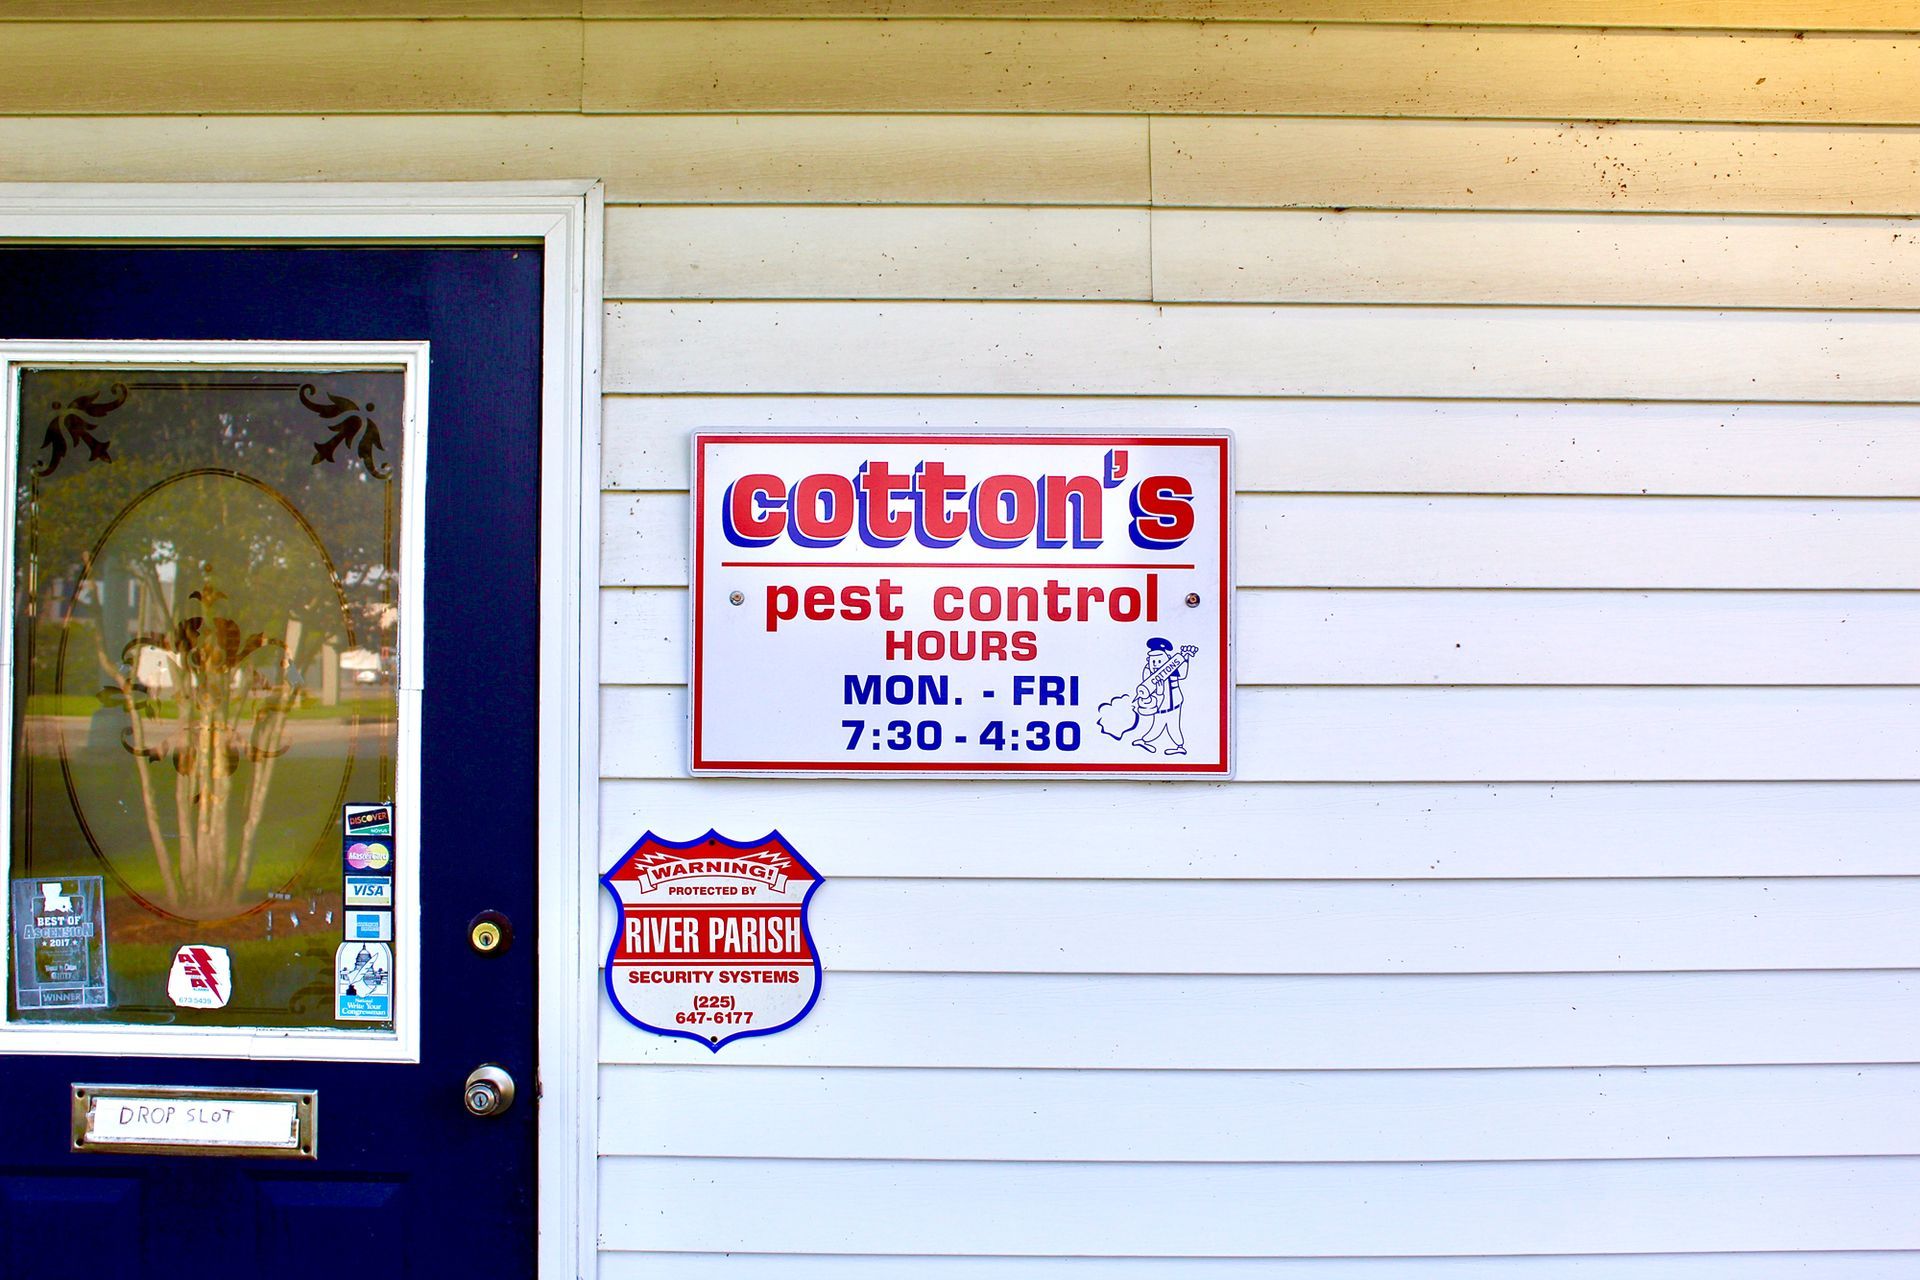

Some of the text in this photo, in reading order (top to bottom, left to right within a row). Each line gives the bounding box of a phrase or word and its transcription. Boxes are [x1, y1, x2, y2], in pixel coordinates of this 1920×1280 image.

[722, 448, 1195, 550] cotton's
[766, 574, 1158, 631] pest control
[886, 631, 1038, 661] HOURS
[1151, 658, 1181, 685] COTTONS
[844, 675, 963, 706] MON.
[1013, 676, 1079, 706] FRI
[842, 720, 942, 751] 7:30
[979, 721, 1081, 751] 4:30
[350, 812, 387, 825] DISCOVER
[652, 861, 774, 880] WARNING!
[354, 885, 384, 896] VISA
[669, 887, 756, 895] PROTECTED BY
[37, 916, 81, 926] BEST OF
[626, 916, 801, 953] RIVER PARISH
[50, 939, 70, 947] 2017
[629, 971, 799, 983] SECURITY SYSTEMS
[42, 992, 81, 1002] WINNER
[693, 995, 736, 1010] (225)
[342, 1008, 386, 1016] Congressman
[366, 1002, 382, 1010] Your
[676, 1012, 753, 1024] 647-6177
[120, 1106, 176, 1125] DROP
